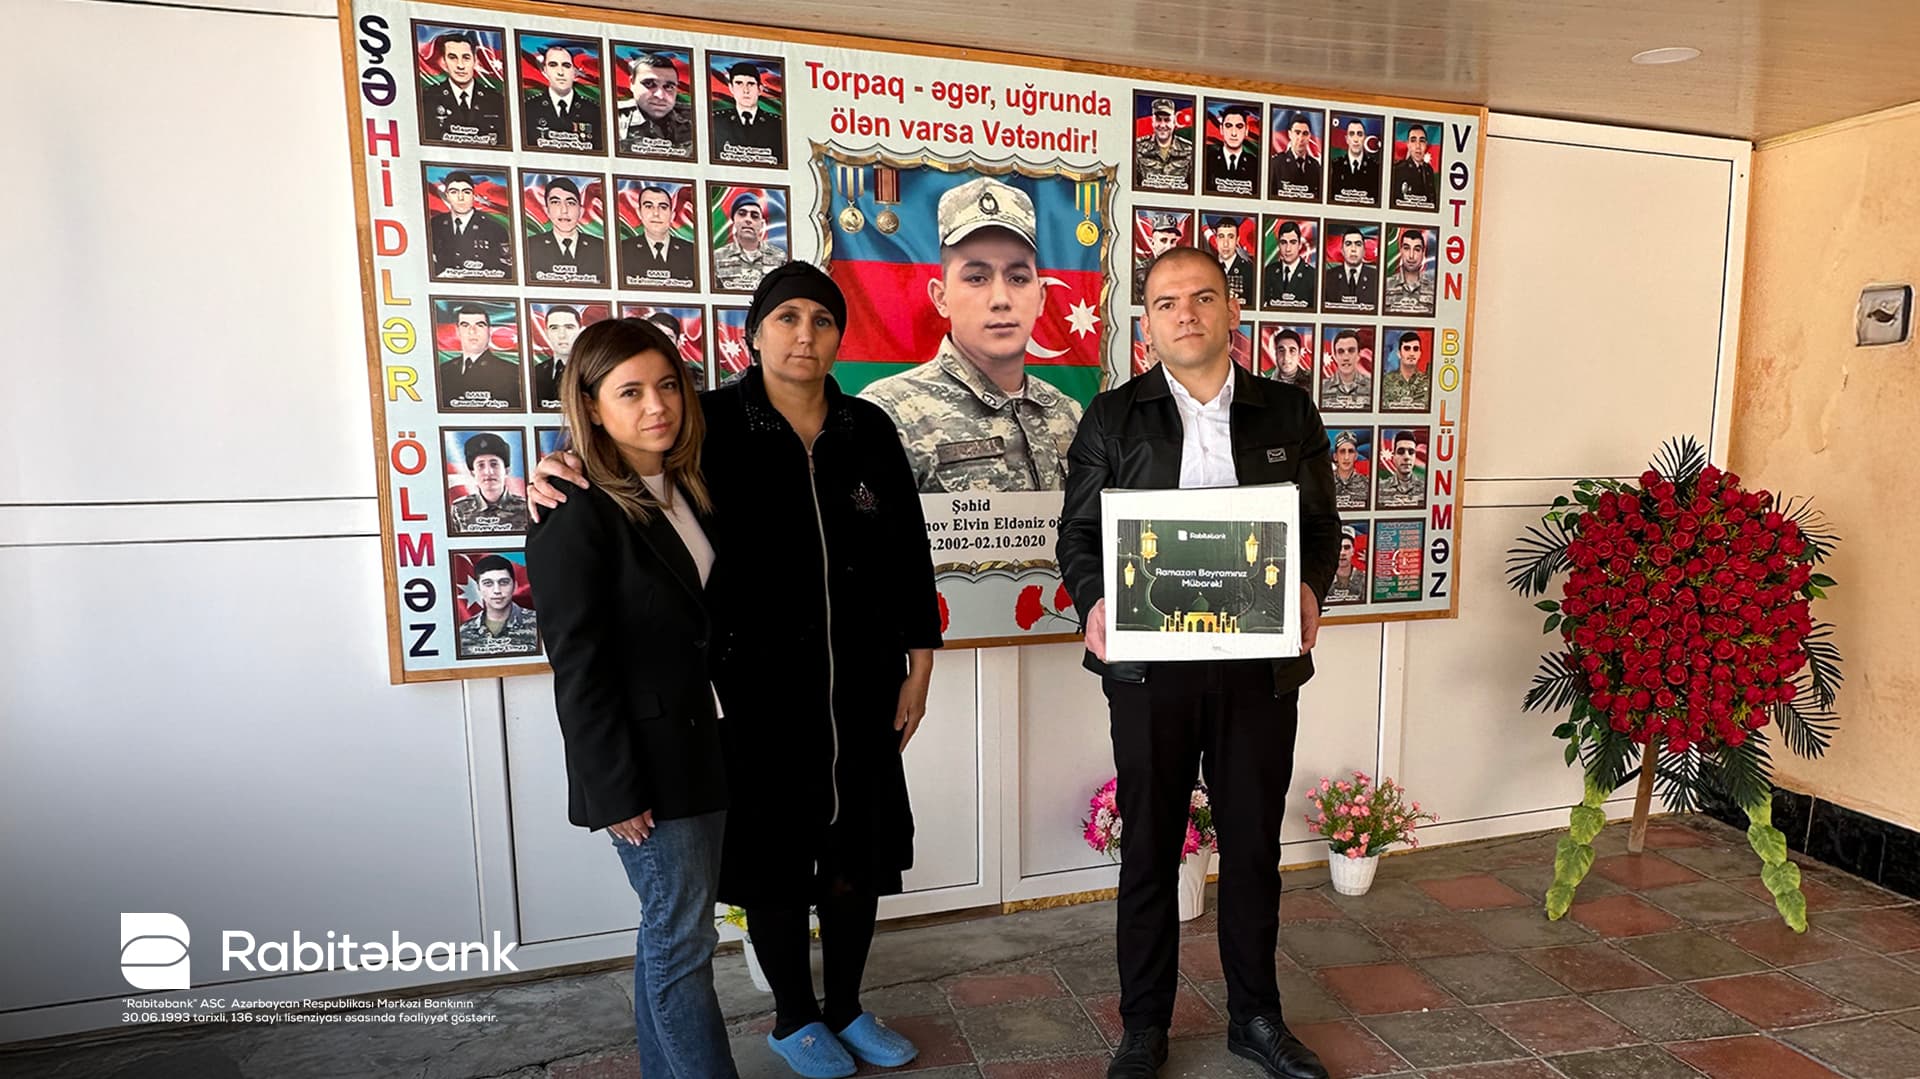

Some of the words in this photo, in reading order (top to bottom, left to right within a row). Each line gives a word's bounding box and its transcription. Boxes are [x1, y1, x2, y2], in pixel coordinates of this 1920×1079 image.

[805, 61, 904, 103] Torpaq
[931, 81, 996, 109] əgər,
[1006, 83, 1112, 117] uğrunda
[830, 107, 890, 137] ölən
[900, 119, 974, 144] varsa
[982, 120, 1098, 154] Vətəndir!
[1444, 123, 1472, 300] VƏTƏN
[952, 500, 990, 514] Şəhid
[953, 519, 989, 530] Elvin
[994, 517, 1045, 529] Eldəniz
[391, 431, 439, 657] ÖLMƏZ
[1156, 568, 1196, 576] Ramazan
